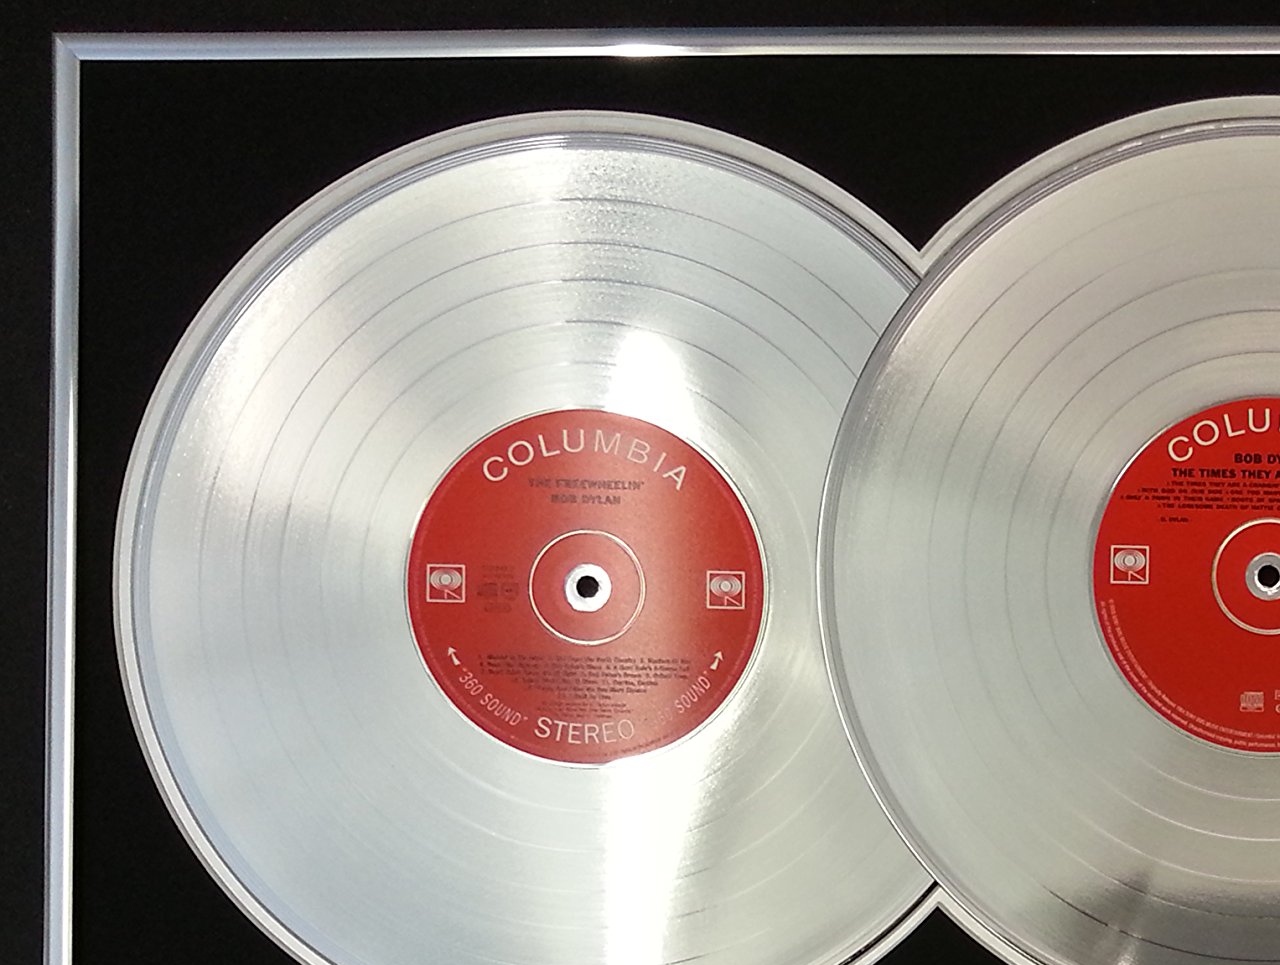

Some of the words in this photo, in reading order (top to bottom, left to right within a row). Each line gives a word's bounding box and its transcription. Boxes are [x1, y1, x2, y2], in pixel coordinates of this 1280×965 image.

[482, 429, 687, 491] COLUMBIA
[1234, 453, 1262, 463] BOB
[1172, 468, 1196, 477] THE
[1199, 468, 1236, 478] TIMES
[1241, 469, 1271, 479] THEY
[529, 478, 551, 488] THE
[533, 716, 634, 744] STEREO
